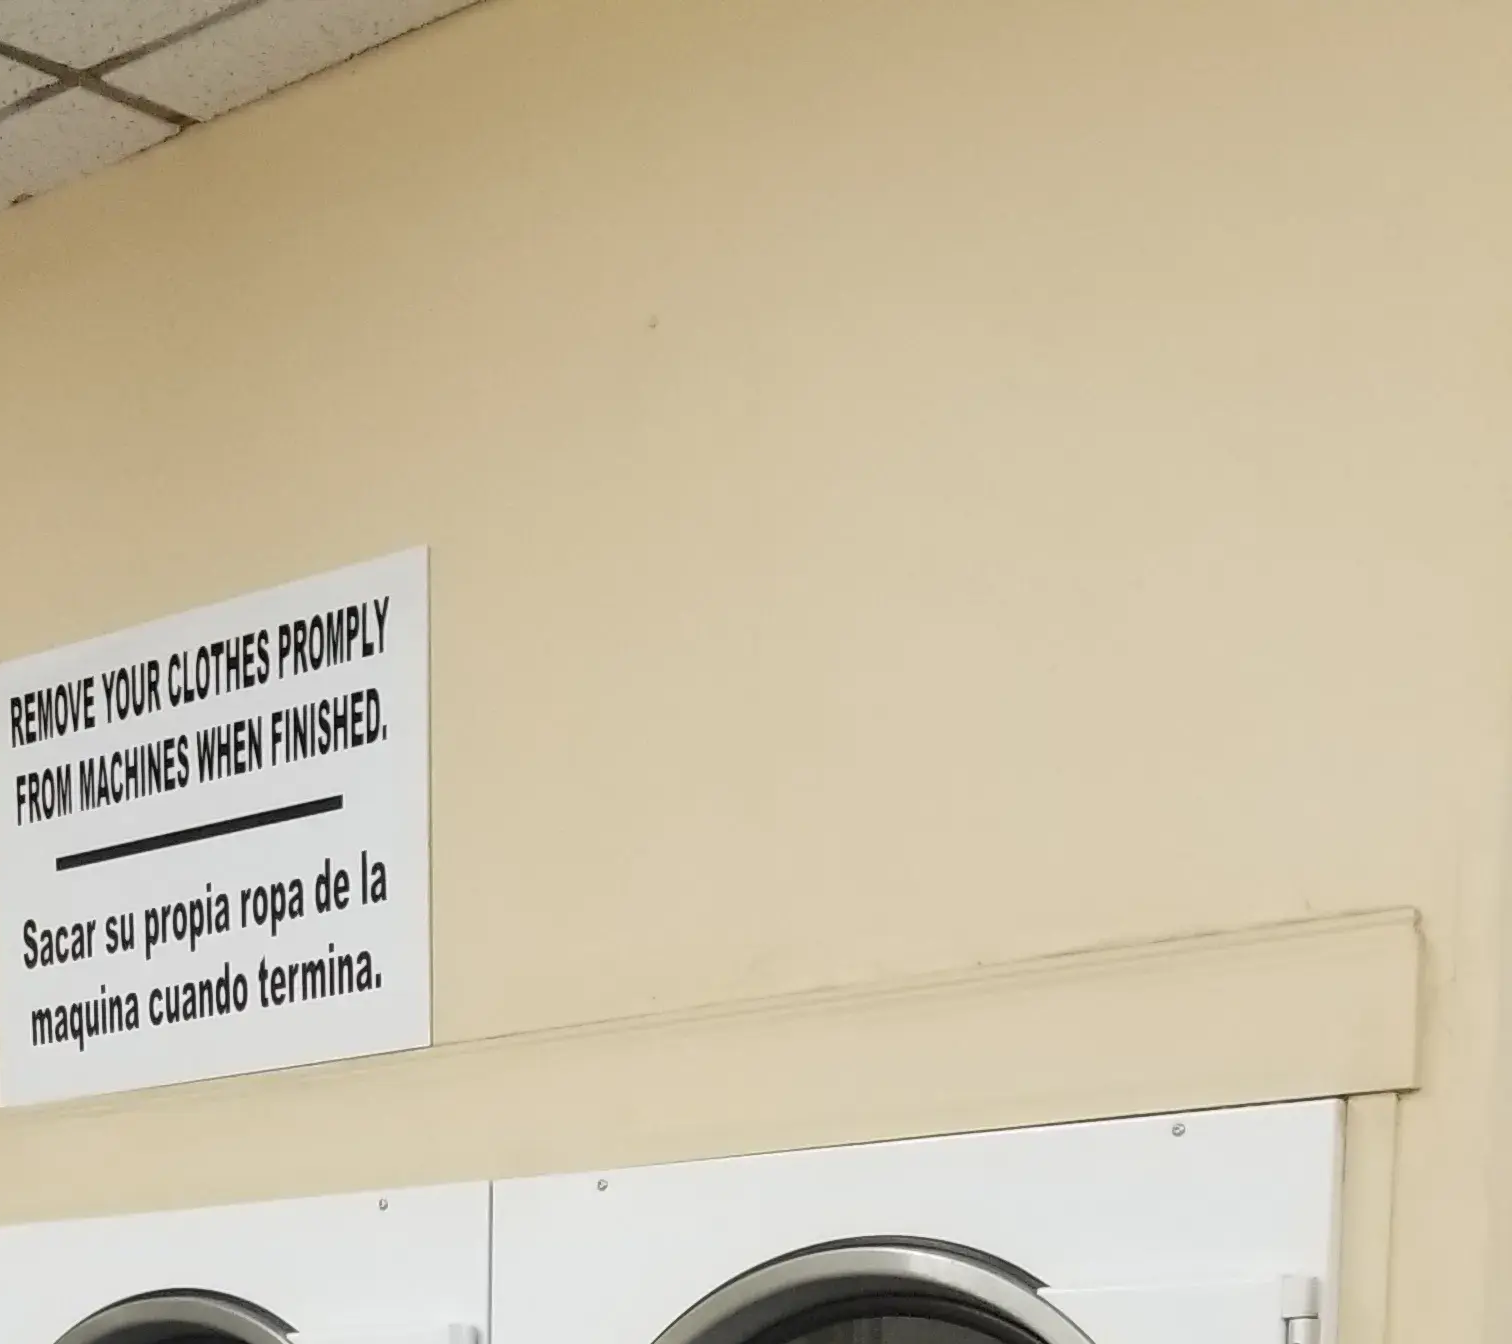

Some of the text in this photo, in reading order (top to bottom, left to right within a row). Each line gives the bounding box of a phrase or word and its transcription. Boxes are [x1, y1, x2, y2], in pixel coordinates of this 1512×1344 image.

[10, 596, 389, 748] REMOVE YOUR CLOTHES PROMPLY
[16, 688, 387, 826] FROM MACHINES WHEN FINISHED.
[23, 850, 387, 969] Sacar su propia ropa de la
[31, 943, 382, 1052] maquina cuando termina.
